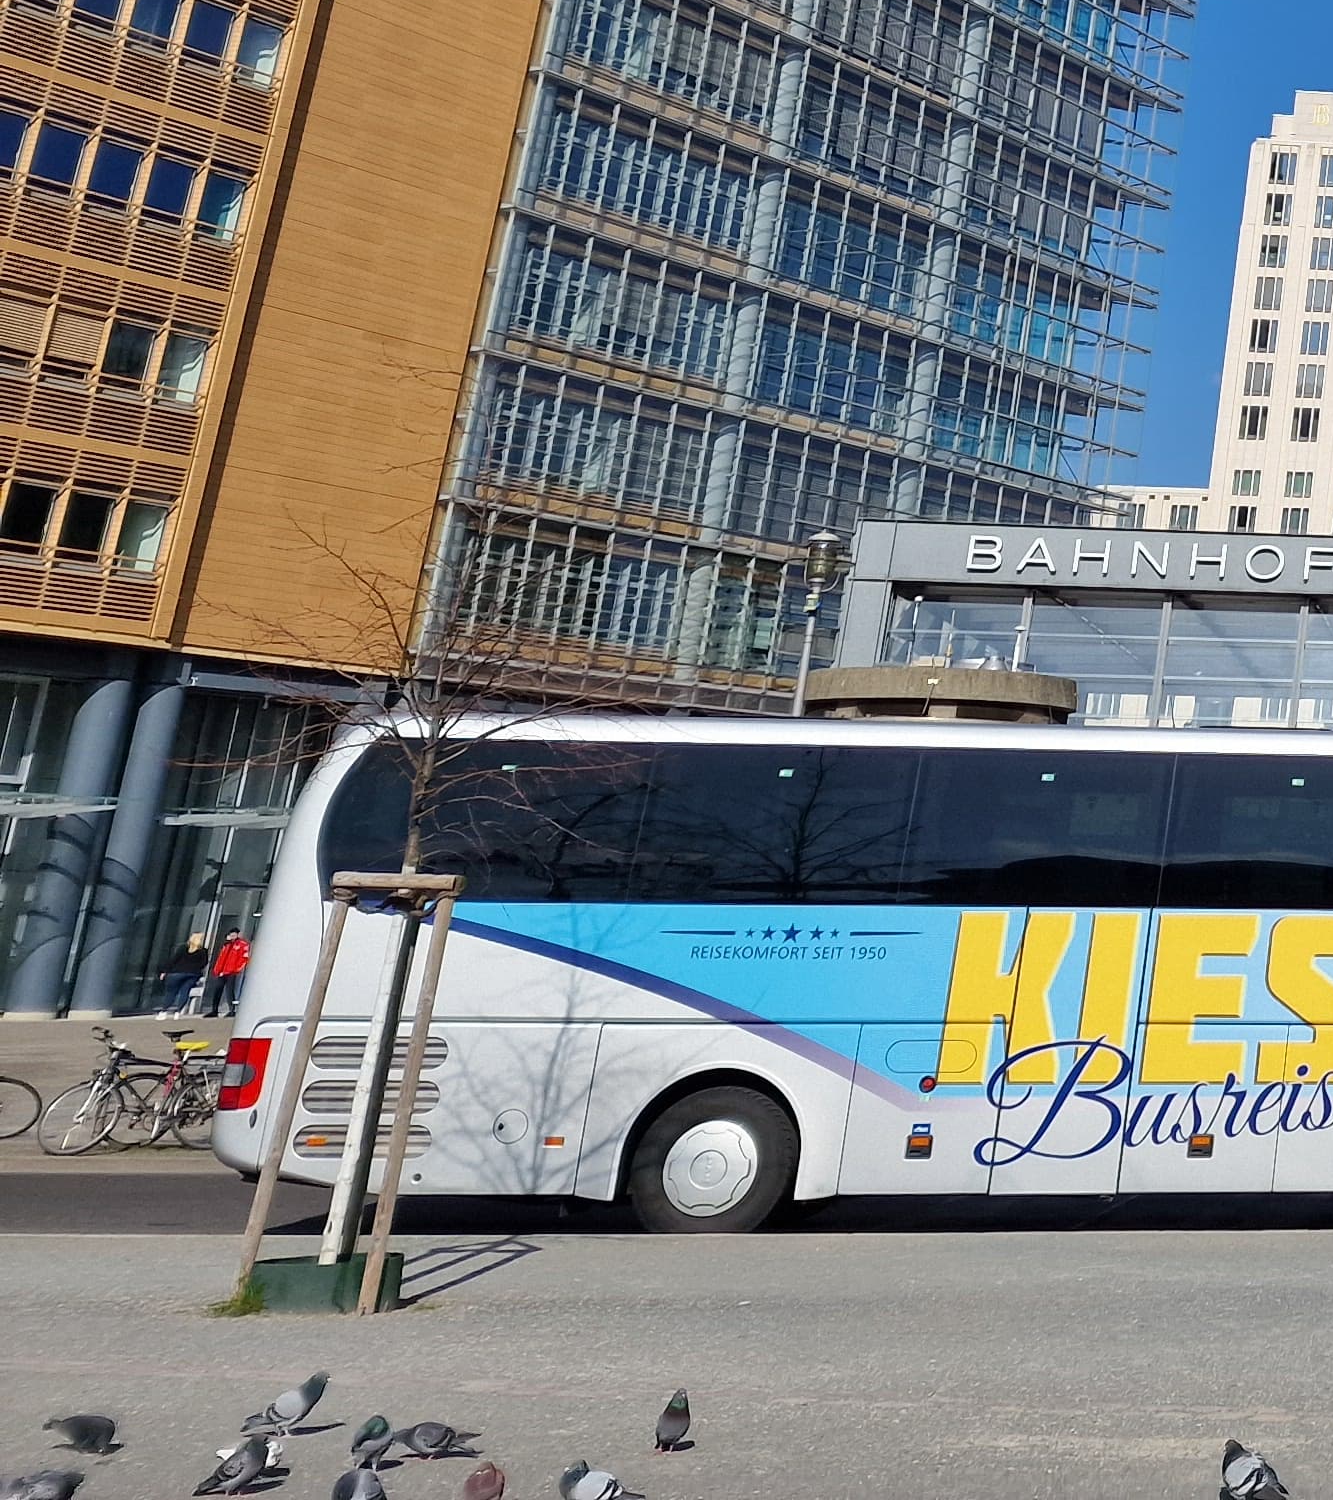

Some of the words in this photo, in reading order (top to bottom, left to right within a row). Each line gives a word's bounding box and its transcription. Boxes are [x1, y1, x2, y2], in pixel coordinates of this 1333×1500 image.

[690, 945, 808, 960] REISEKOMFORT
[812, 946, 843, 960] SEIT
[849, 946, 887, 960] 1950
